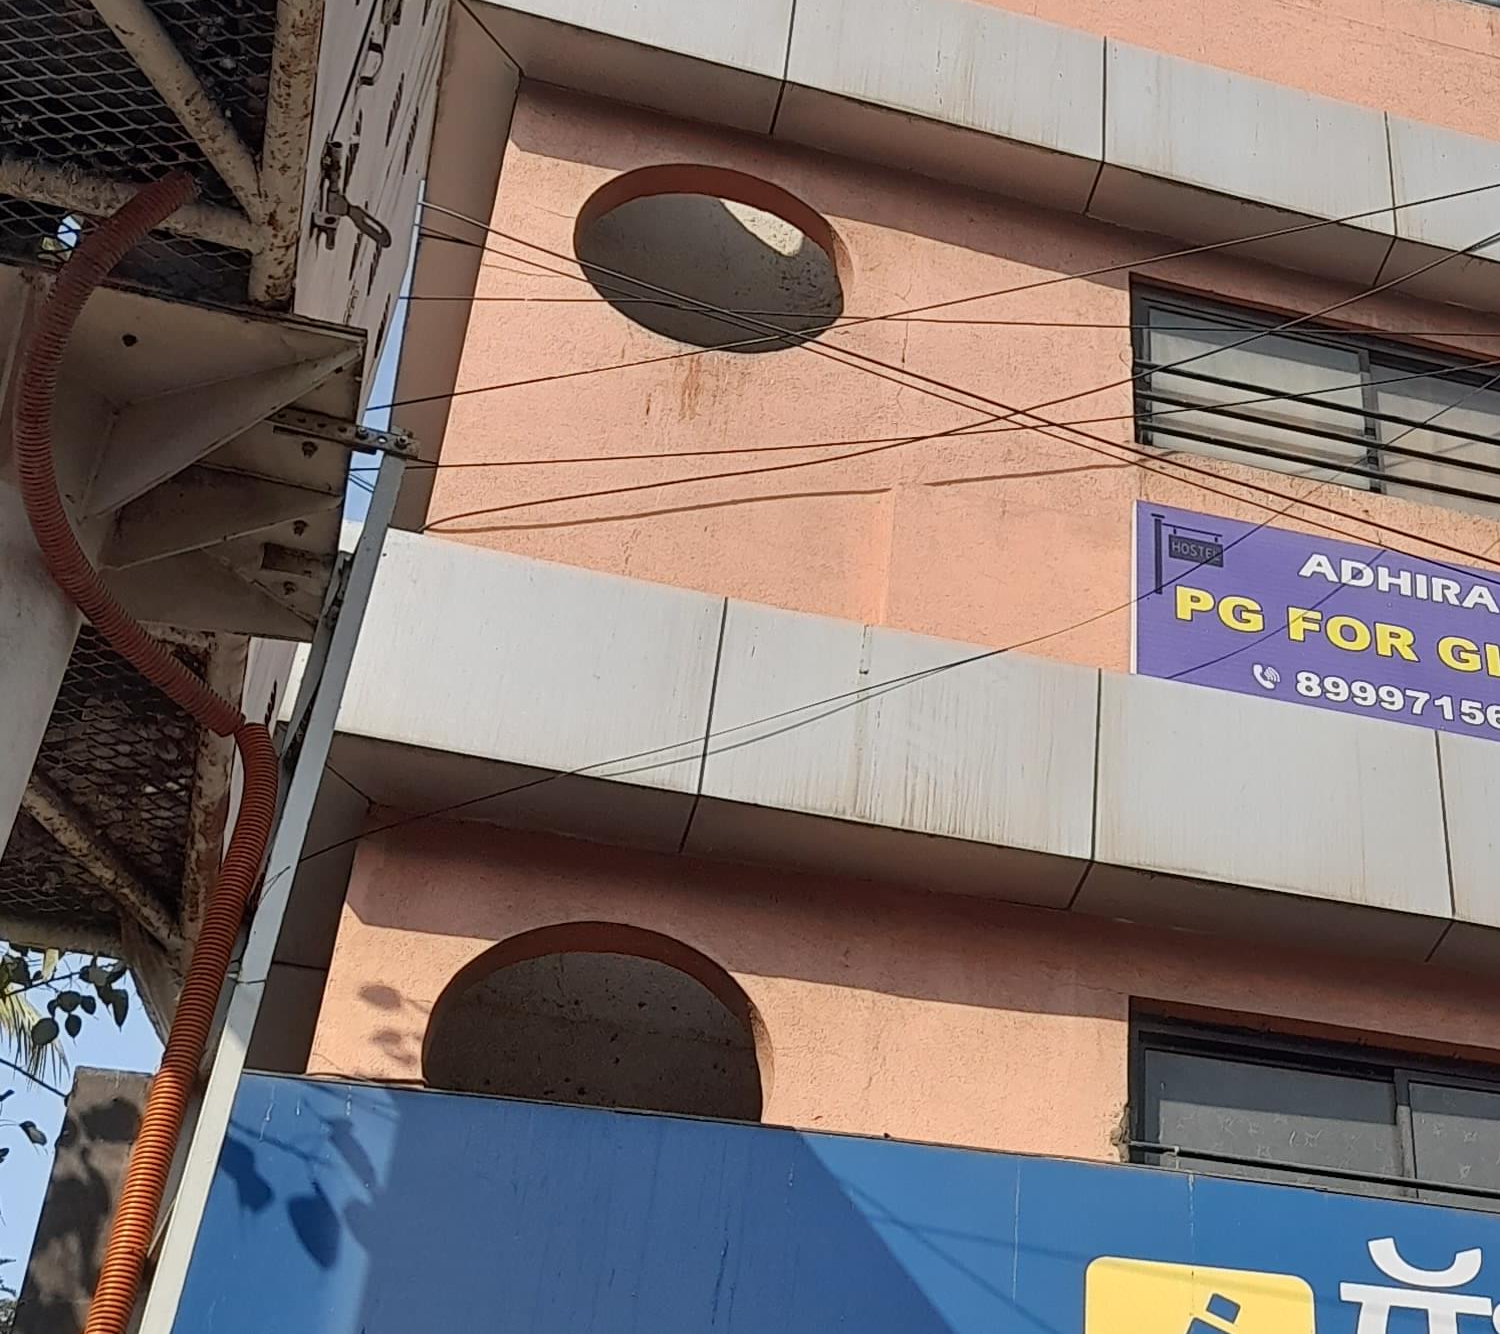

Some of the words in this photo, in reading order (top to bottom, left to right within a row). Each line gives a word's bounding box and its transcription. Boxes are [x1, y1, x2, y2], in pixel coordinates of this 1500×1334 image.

[1299, 553, 1500, 614] ADHIRA
[1174, 585, 1265, 633] PG
[1287, 606, 1420, 663] FOR
